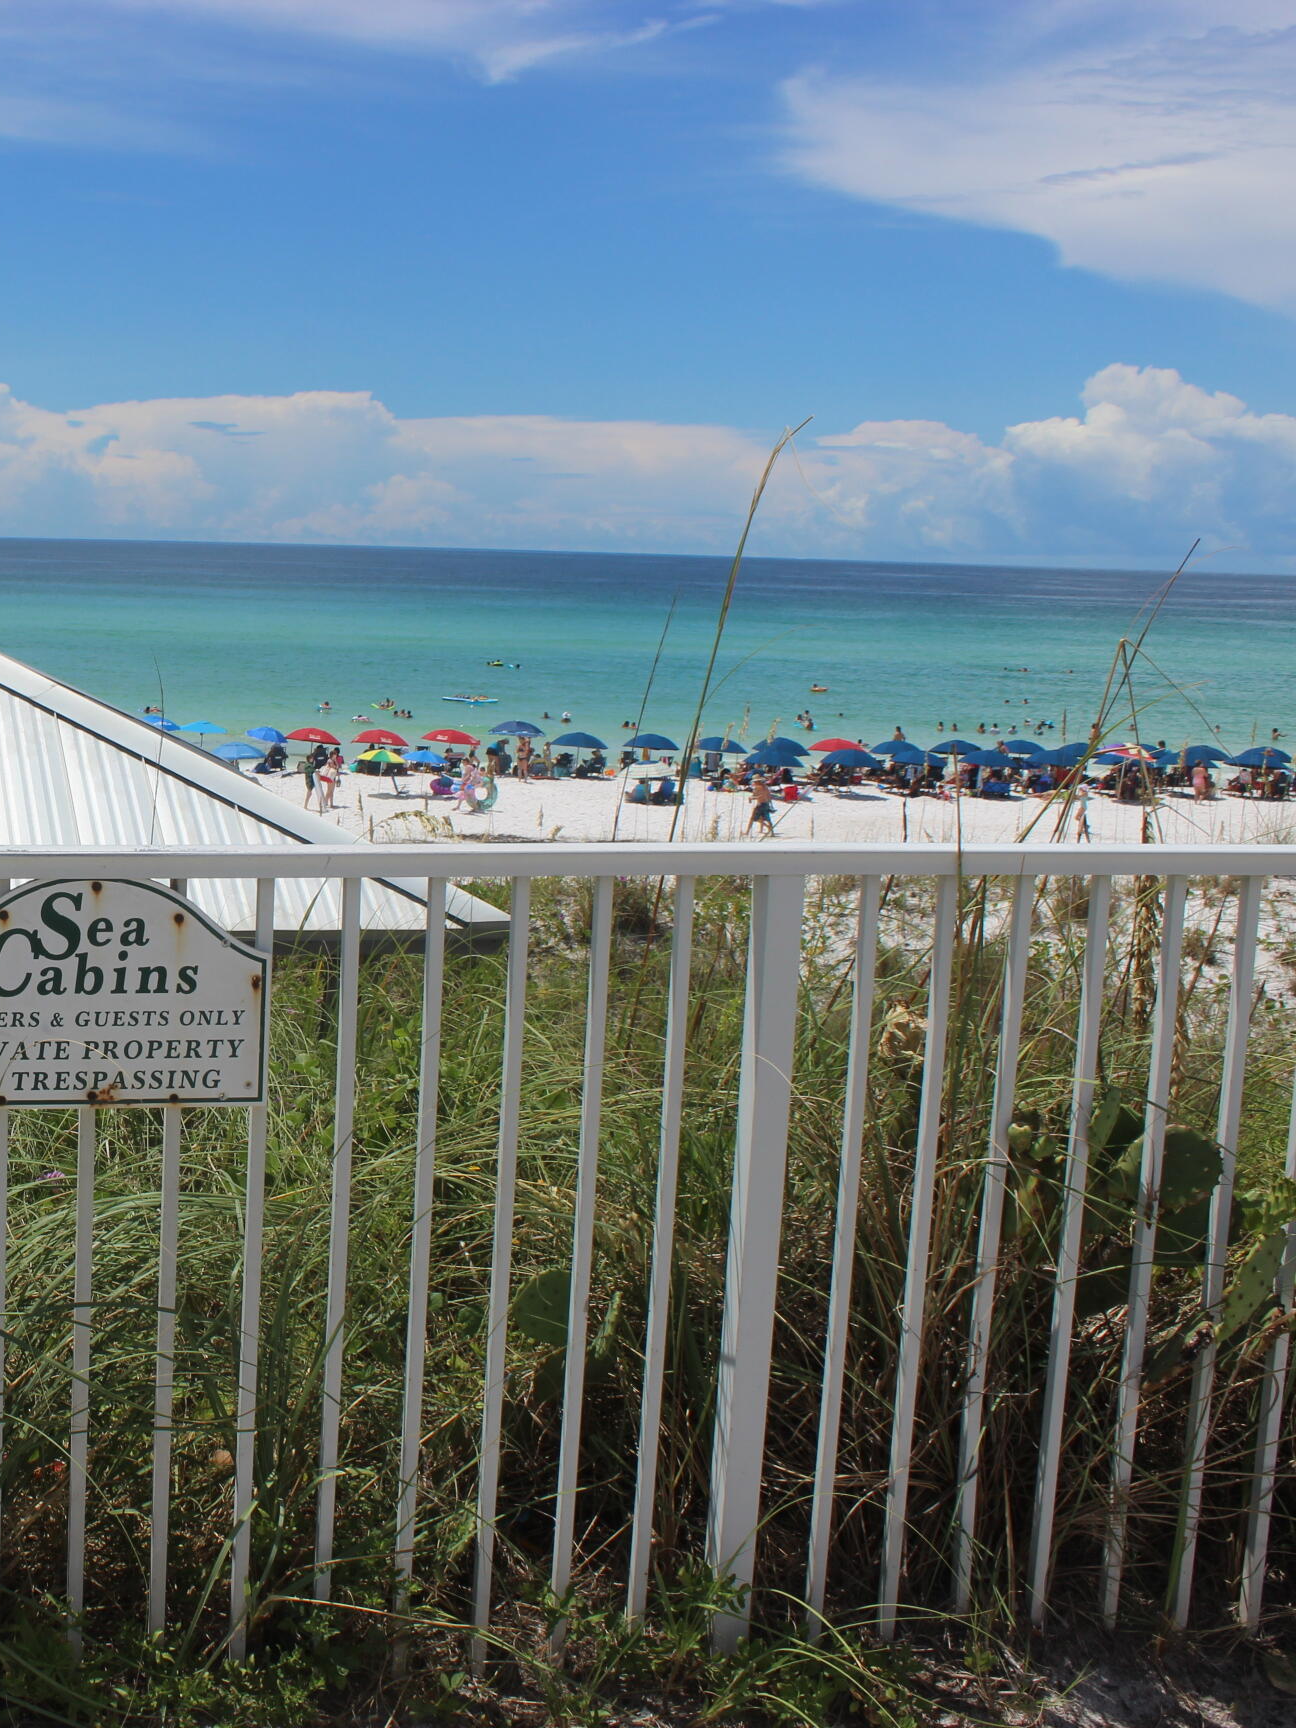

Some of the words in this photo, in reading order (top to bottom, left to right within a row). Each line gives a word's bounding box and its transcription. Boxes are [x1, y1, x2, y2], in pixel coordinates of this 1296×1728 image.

[40, 892, 150, 961] Sea
[50, 1012, 64, 1028] &
[75, 1010, 170, 1028] GUESTS
[179, 1009, 246, 1027] ONLY
[81, 1038, 245, 1060] PROPERTY
[11, 1069, 222, 1092] TRESPASSING
